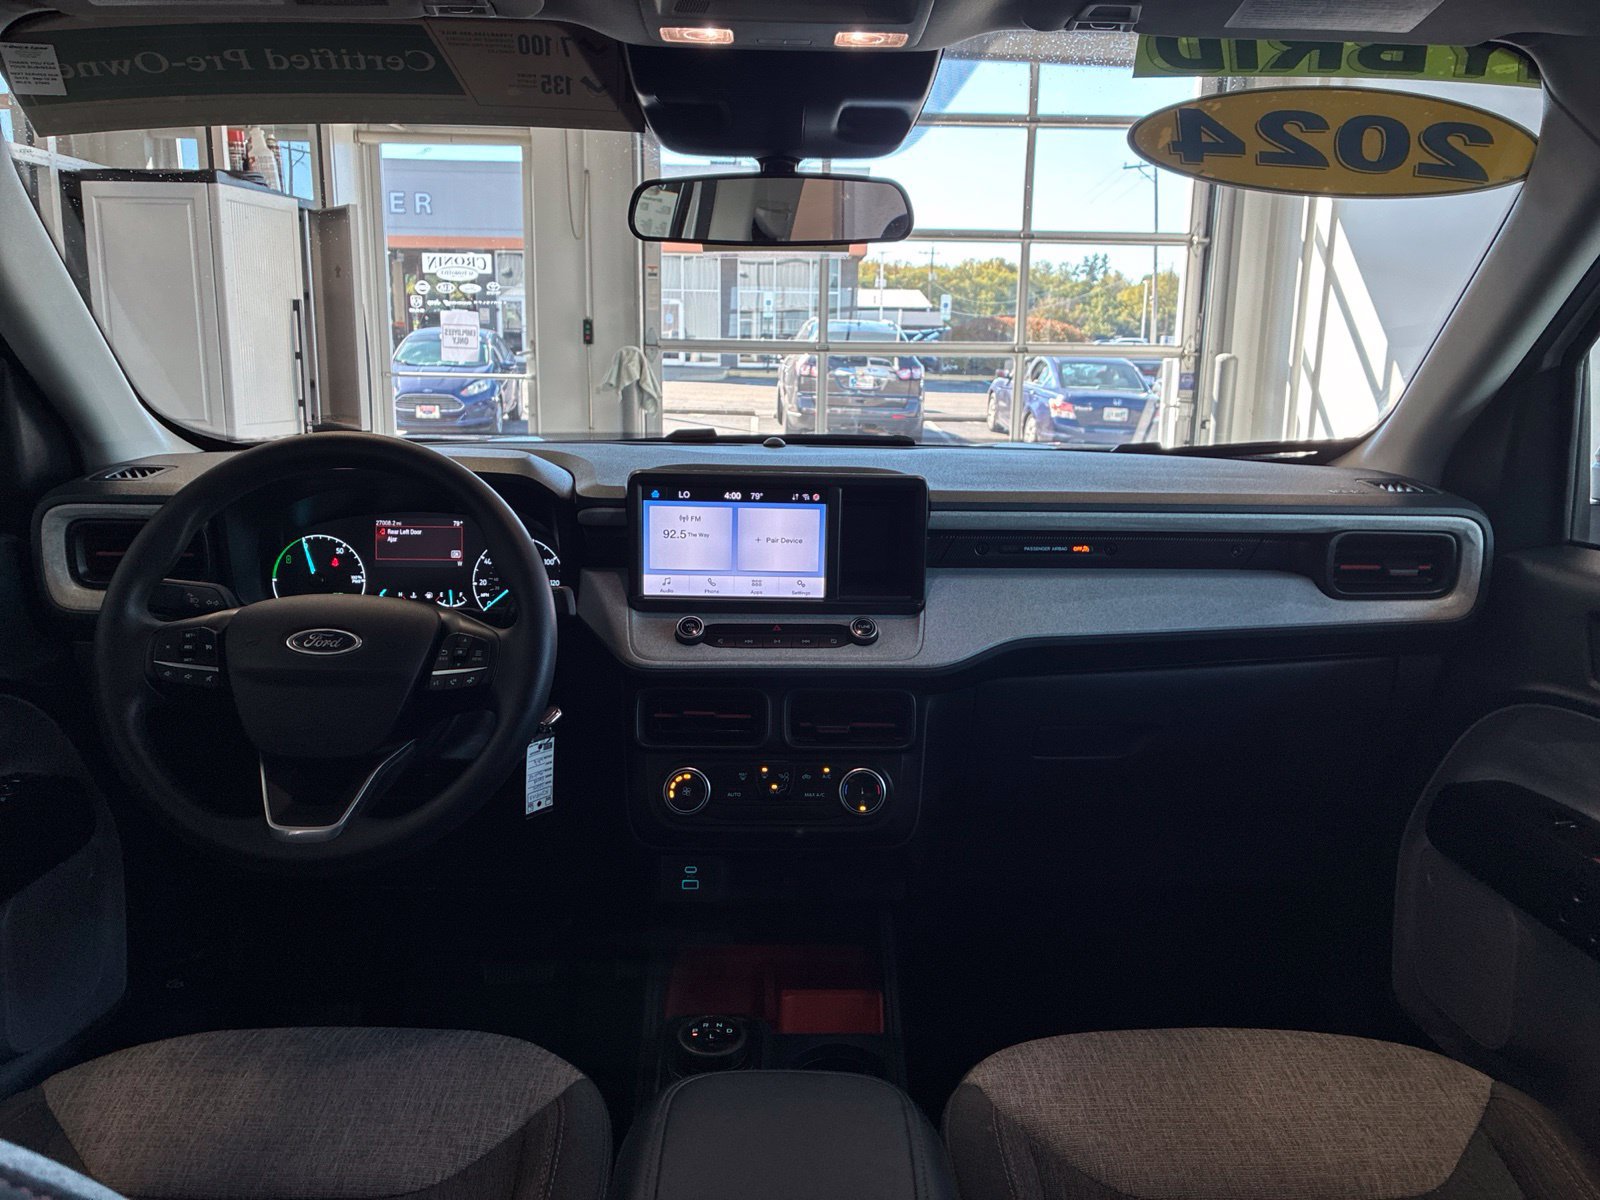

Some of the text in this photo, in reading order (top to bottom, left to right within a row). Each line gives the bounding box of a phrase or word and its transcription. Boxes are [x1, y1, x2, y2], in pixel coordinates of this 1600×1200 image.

[678, 490, 690, 499] LO
[724, 491, 742, 500] 4:00
[750, 492, 764, 500] 79°
[662, 529, 687, 539] 92.5
[303, 632, 344, 648] Ford
